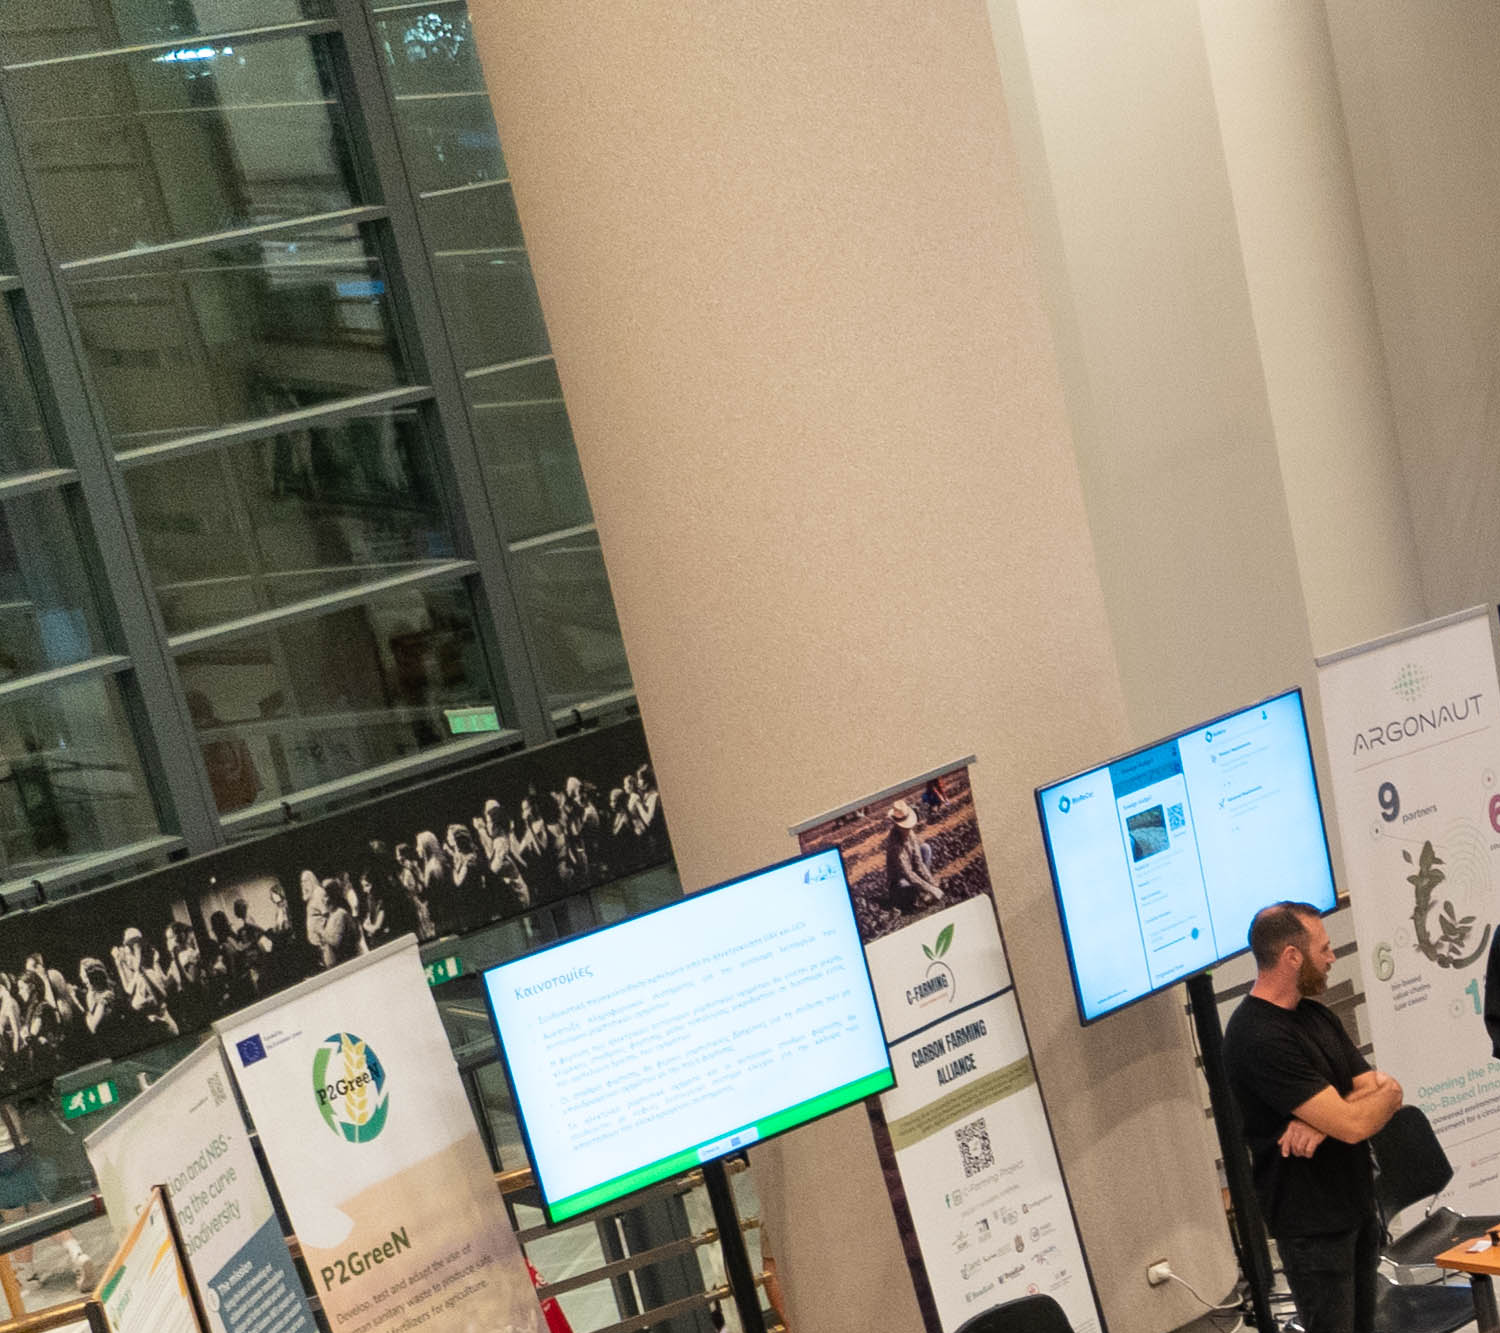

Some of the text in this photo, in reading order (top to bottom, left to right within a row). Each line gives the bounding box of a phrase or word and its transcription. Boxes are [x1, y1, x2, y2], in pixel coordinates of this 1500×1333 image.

[1353, 694, 1483, 756] ARGONAUT
[1378, 782, 1438, 824] 9 partners
[1373, 944, 1395, 981] 6
[906, 973, 949, 1006] C-FARMING
[1465, 978, 1482, 1014] 1
[911, 1019, 988, 1069] CARBON FARMING
[317, 1061, 382, 1105] P2GreeN
[937, 1053, 977, 1087] ALLIANCE
[1418, 1074, 1466, 1099] Opening
[1467, 1066, 1487, 1083] the
[207, 1135, 227, 1168] NBS
[208, 1167, 237, 1202] curve
[321, 1226, 412, 1292] P2GreeN
[372, 1290, 390, 1304] test
[391, 1280, 407, 1295] and
[409, 1268, 432, 1286] adapt
[431, 1259, 445, 1273] the
[446, 1252, 461, 1263] use
[462, 1243, 472, 1255] of
[373, 1303, 407, 1327] sanitary
[407, 1289, 433, 1307] waste
[432, 1282, 442, 1292] to
[442, 1264, 475, 1290] produce
[431, 1304, 444, 1316] for
